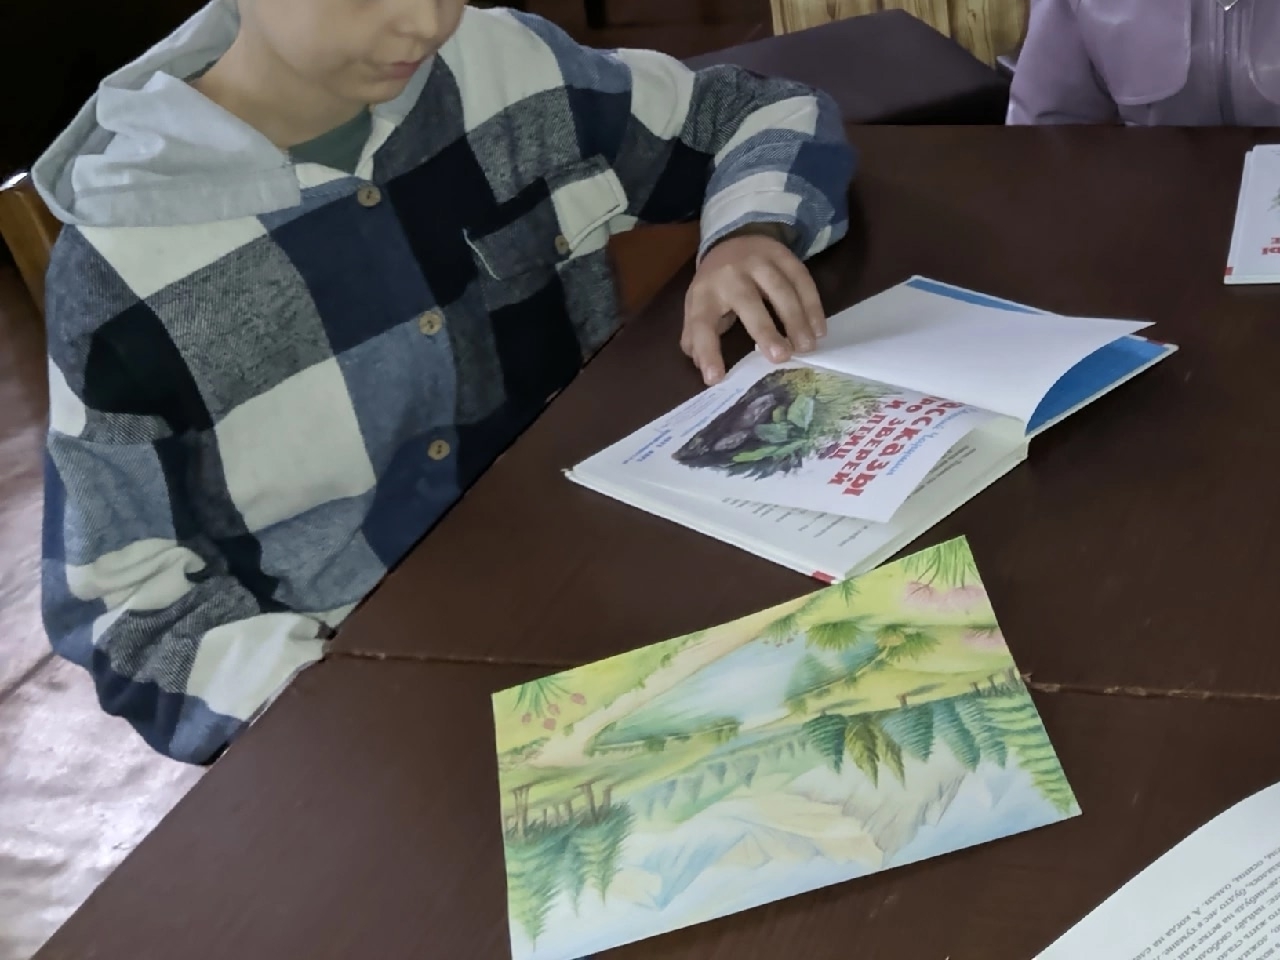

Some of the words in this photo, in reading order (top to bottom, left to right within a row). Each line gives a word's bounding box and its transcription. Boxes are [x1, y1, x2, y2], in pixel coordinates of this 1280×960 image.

[842, 398, 961, 496] ассказы
[1219, 888, 1247, 910] будто
[1165, 915, 1191, 936] когда
[1203, 909, 1217, 923] лес
